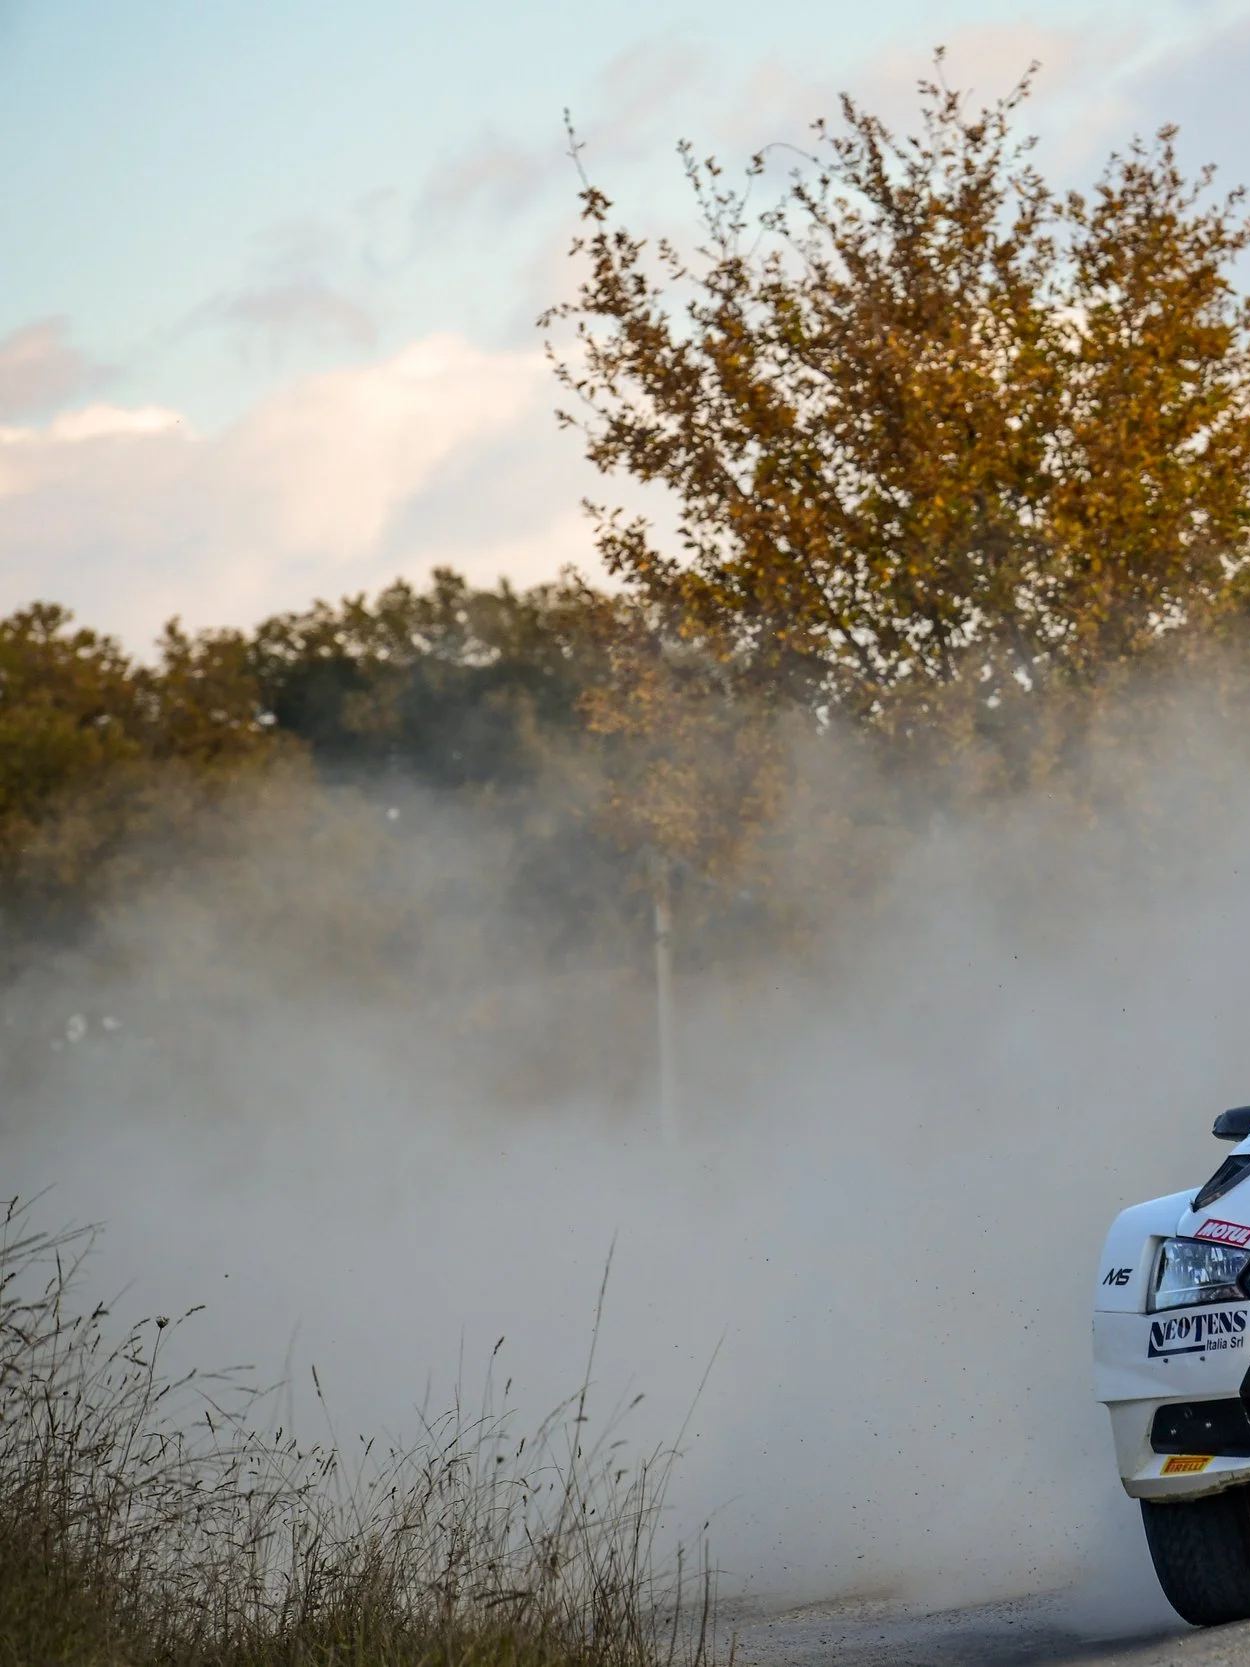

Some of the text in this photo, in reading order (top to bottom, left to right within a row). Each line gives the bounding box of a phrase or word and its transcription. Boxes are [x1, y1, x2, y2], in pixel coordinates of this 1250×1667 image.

[1102, 1268, 1133, 1286] MS
[1149, 1310, 1248, 1349] NEOTENS
[1206, 1336, 1245, 1351] Italia Srl
[1164, 1457, 1210, 1474] PIRELLI
